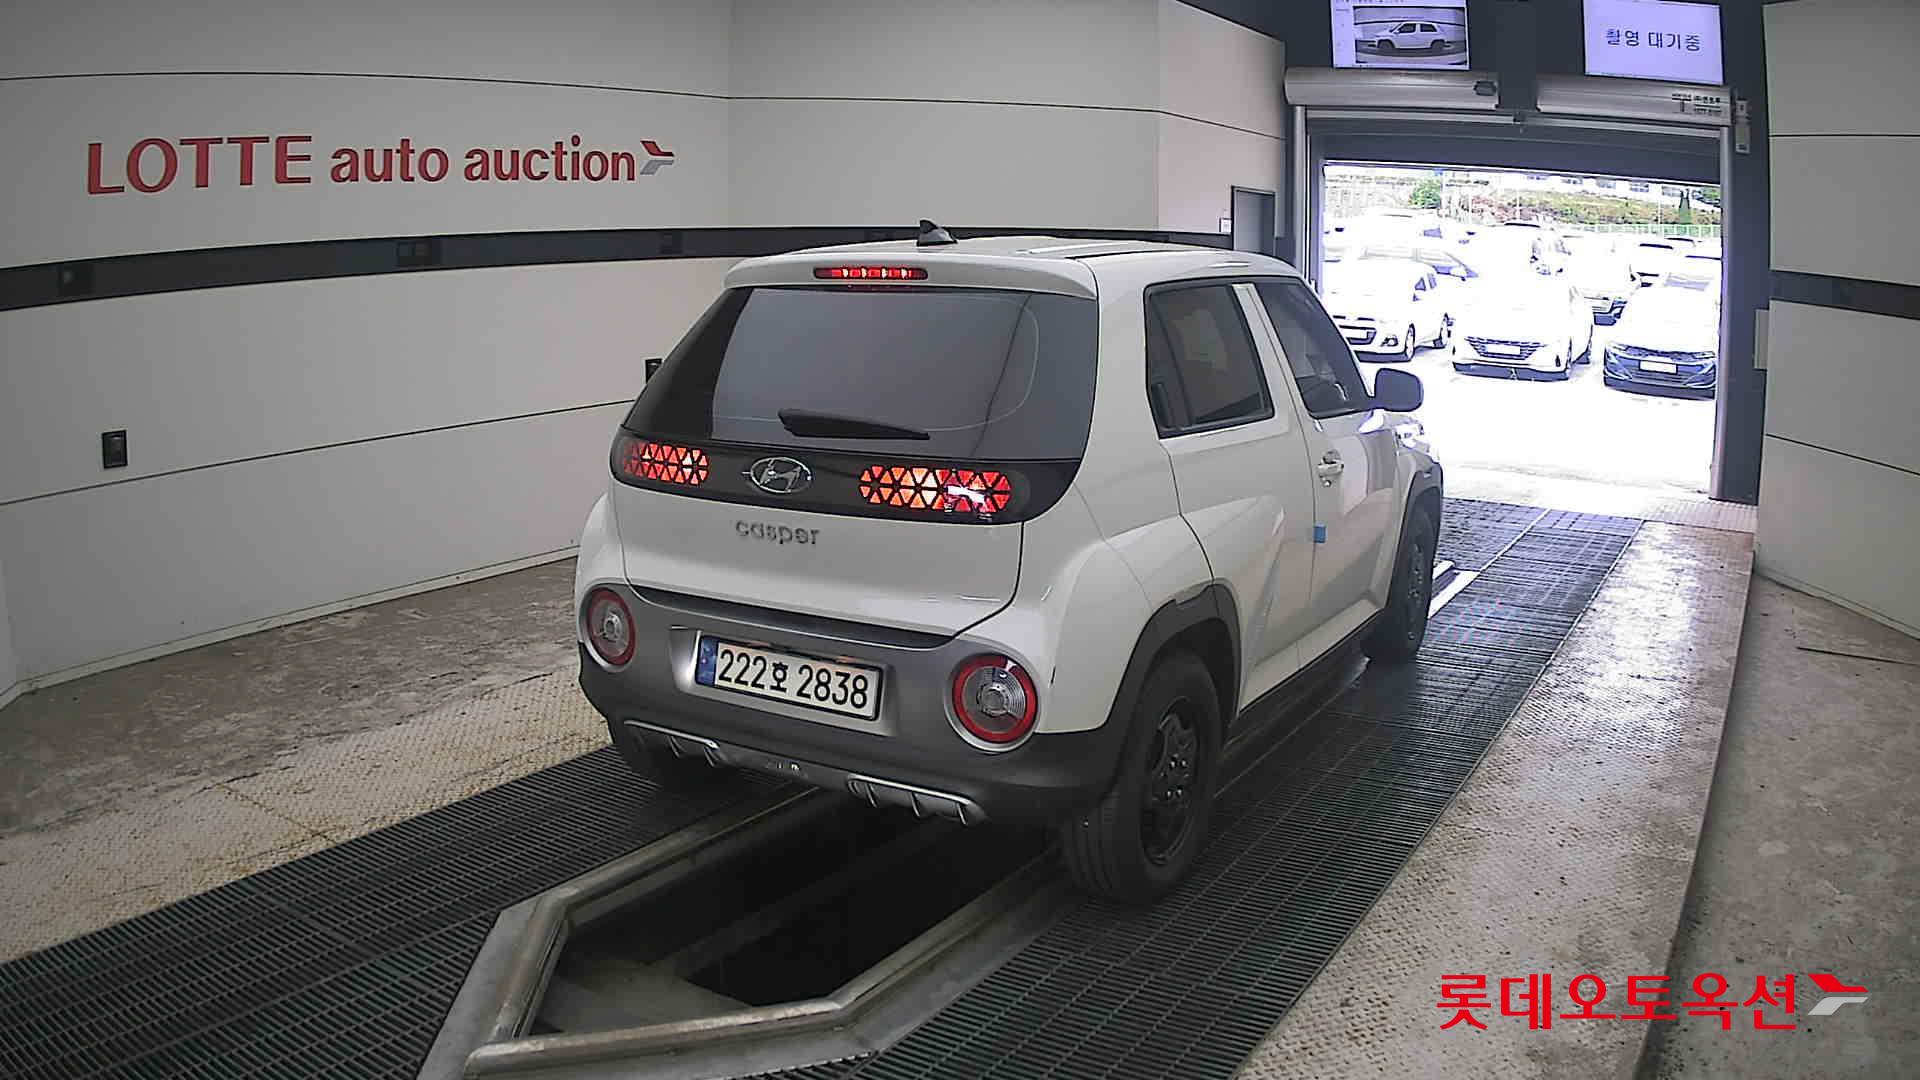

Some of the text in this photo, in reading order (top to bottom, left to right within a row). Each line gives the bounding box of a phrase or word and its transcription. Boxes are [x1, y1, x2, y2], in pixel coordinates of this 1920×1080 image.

[1647, 31, 1701, 52] 대기중
[87, 135, 636, 194] LOTTE auto auction
[735, 521, 819, 544] casper
[718, 648, 869, 709] 222호 2838
